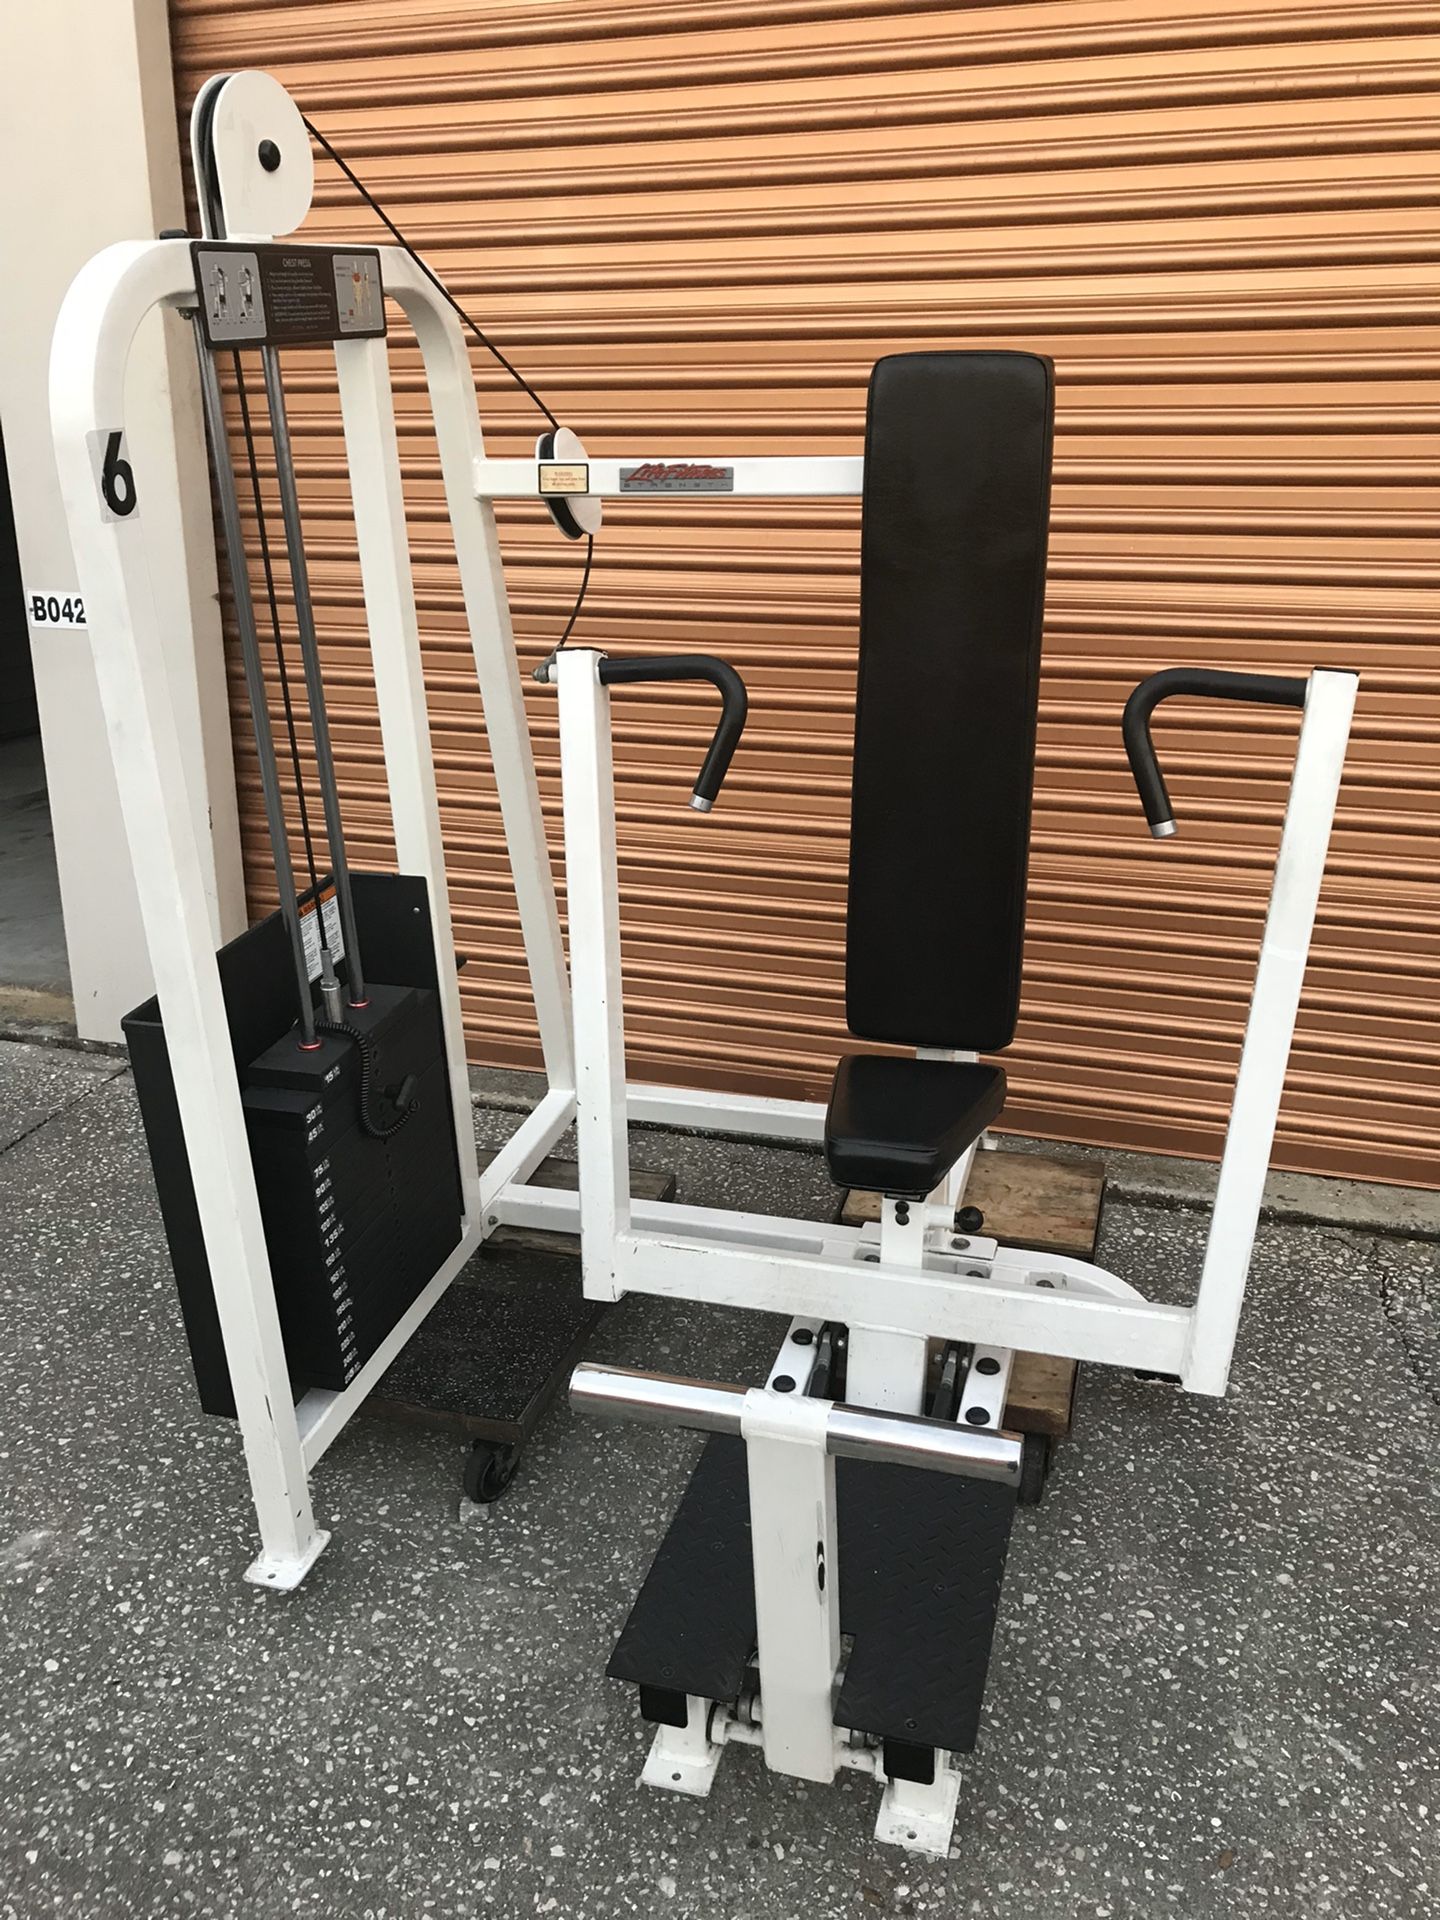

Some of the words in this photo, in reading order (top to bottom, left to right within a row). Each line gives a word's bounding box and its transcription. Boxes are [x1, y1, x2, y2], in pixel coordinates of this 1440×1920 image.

[102, 431, 138, 517] 6
[32, 596, 87, 624] B042
[325, 1070, 334, 1084] 15
[306, 1109, 317, 1124] 30
[314, 1164, 324, 1178] 75
[315, 1183, 326, 1197] 90
[324, 1228, 339, 1247] 135
